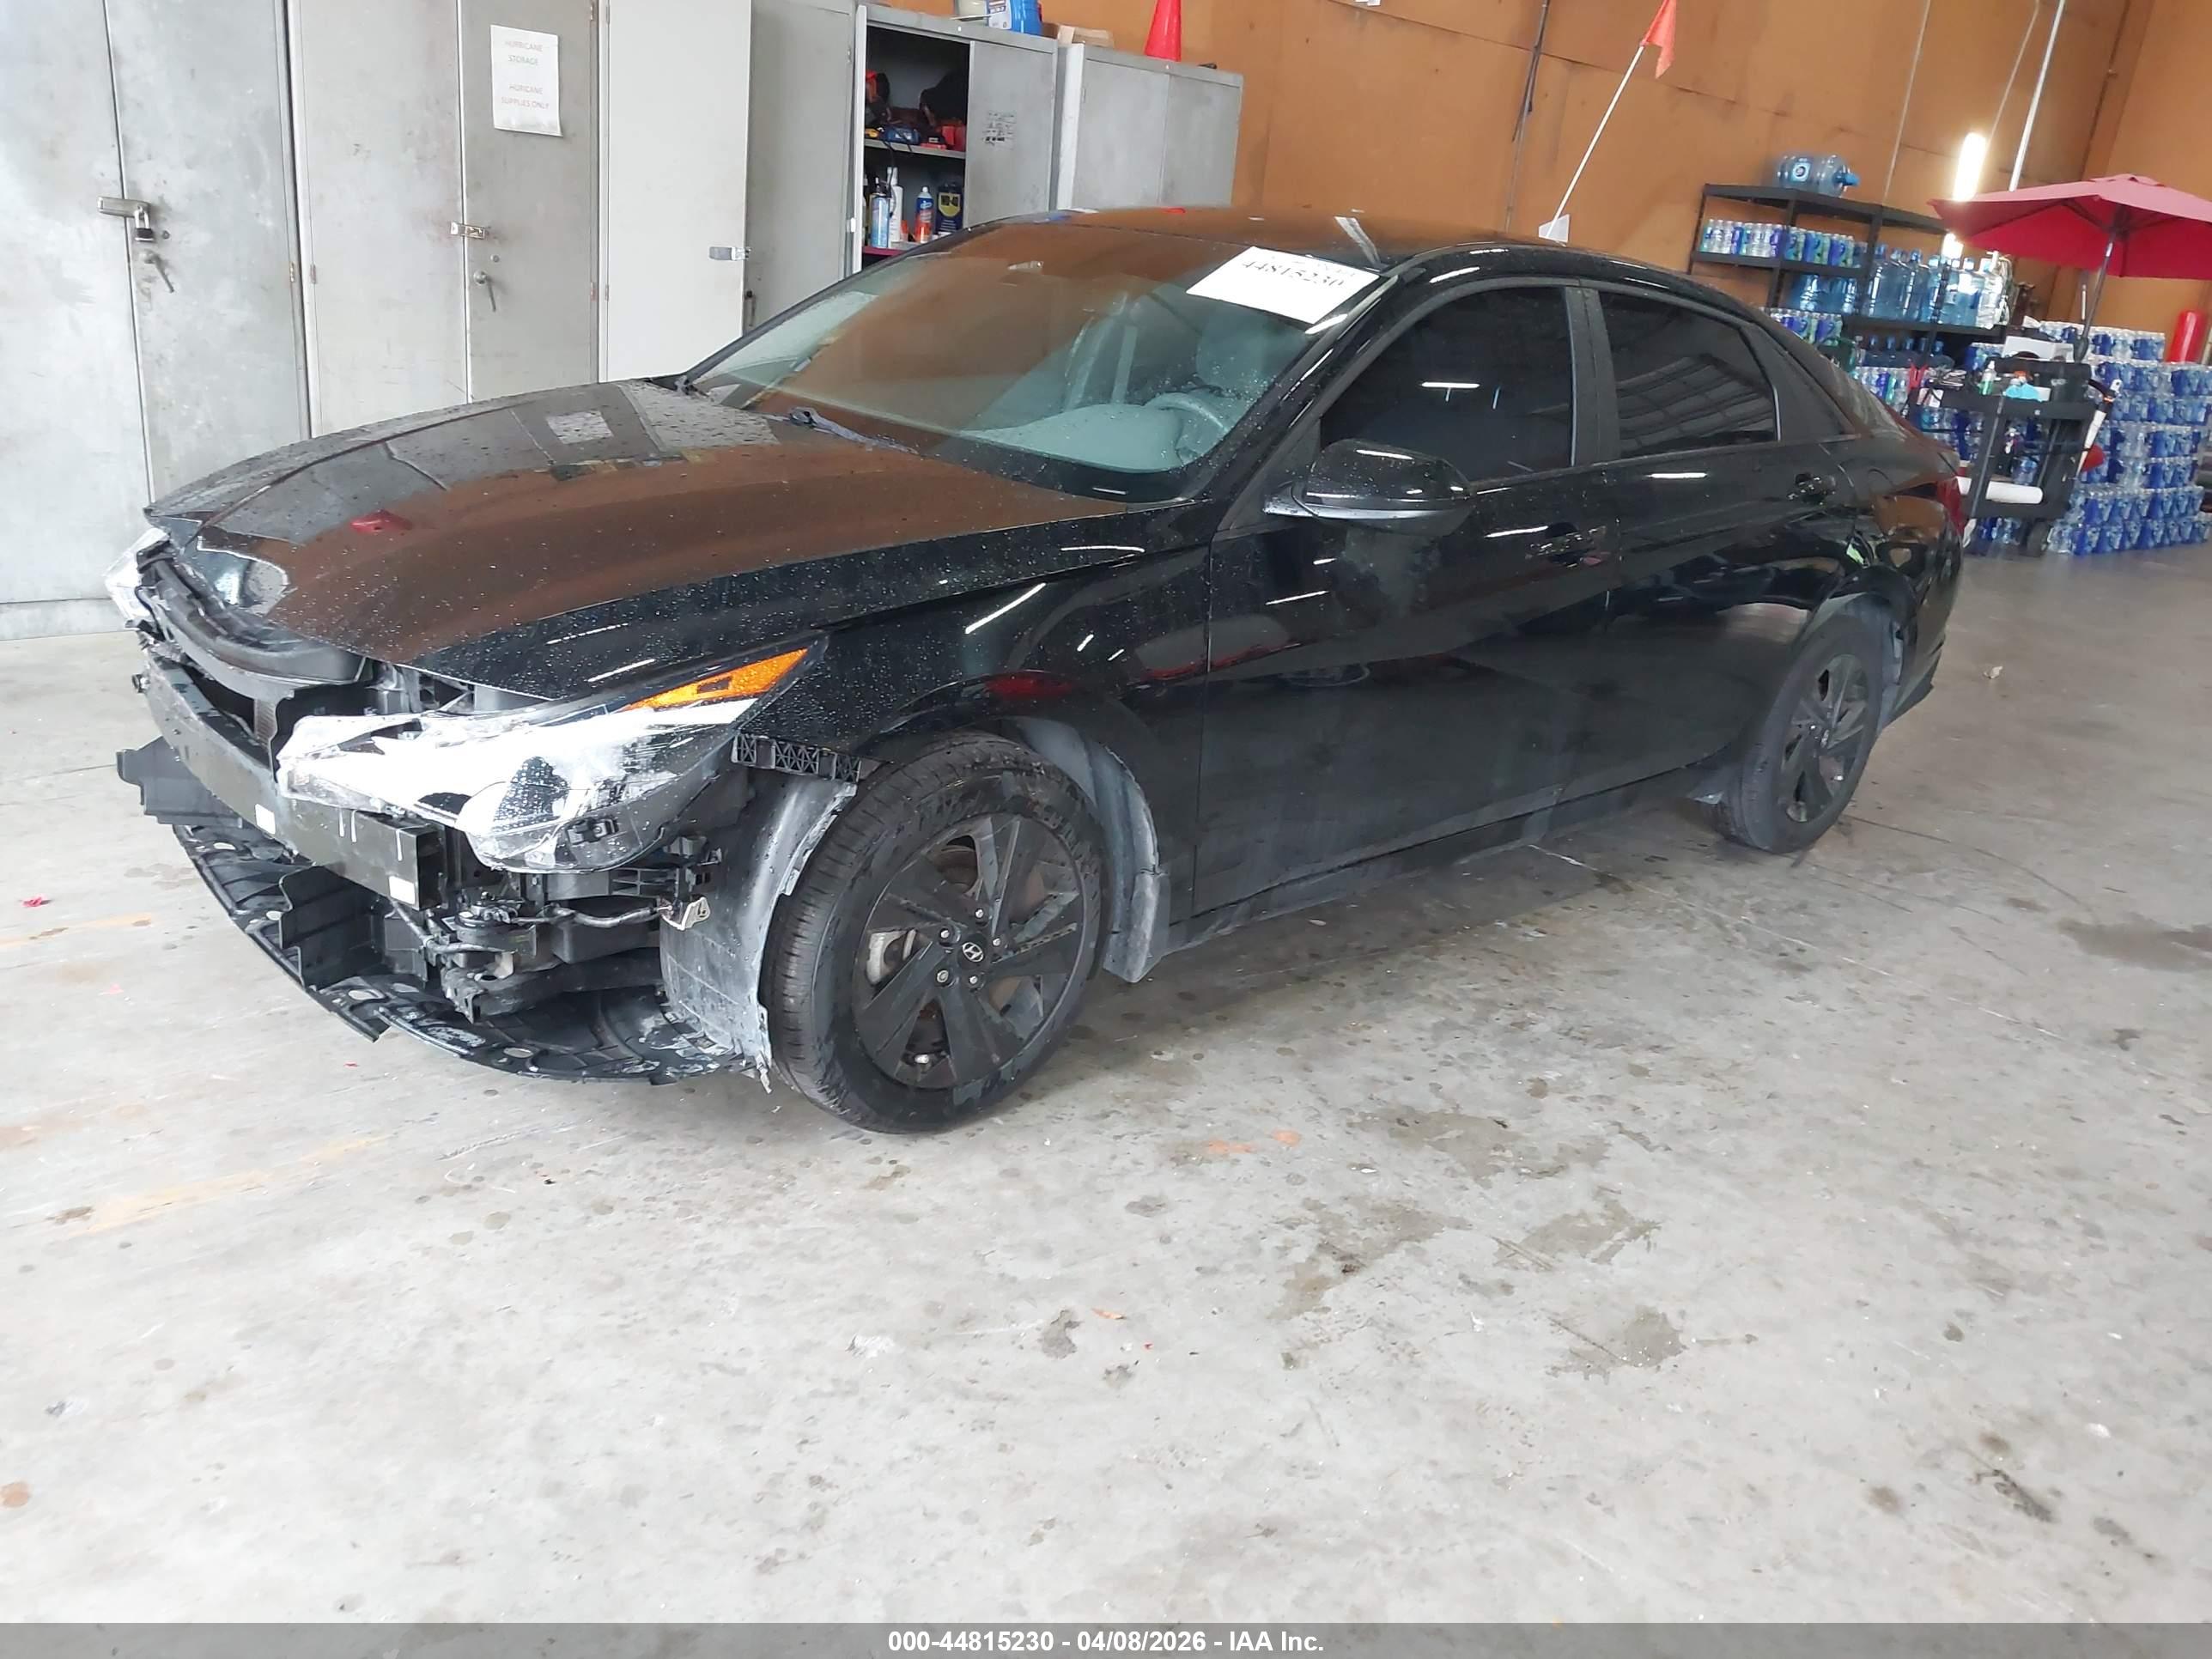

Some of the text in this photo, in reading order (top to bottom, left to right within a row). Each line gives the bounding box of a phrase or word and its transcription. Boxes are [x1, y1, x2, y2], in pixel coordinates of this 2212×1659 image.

[508, 54, 538, 66] STORAGE
[501, 96, 550, 109] SUPPLIES ONLY
